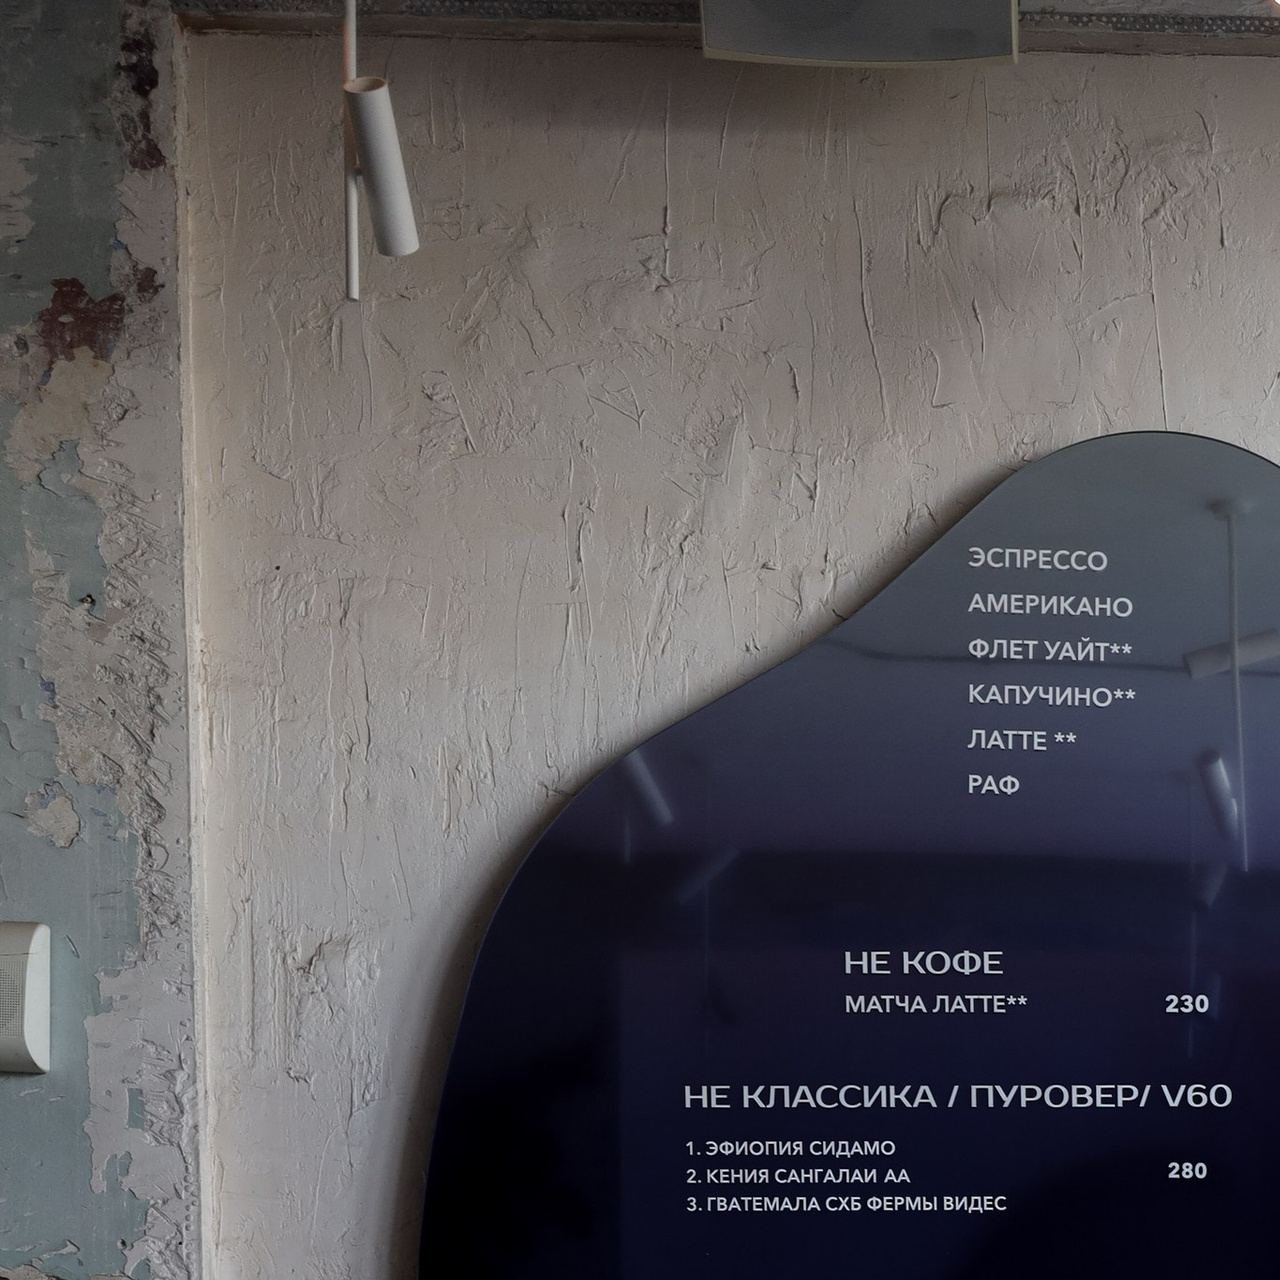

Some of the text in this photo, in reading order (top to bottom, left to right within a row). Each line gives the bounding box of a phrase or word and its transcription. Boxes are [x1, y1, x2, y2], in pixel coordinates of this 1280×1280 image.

[969, 547, 1107, 570] ЭСПРЕССО
[968, 594, 1132, 617] АМЕРИКАНО
[969, 639, 1038, 659] ФЛЕТ
[968, 730, 1046, 750] ЛАТТЕ
[969, 775, 1019, 794] РАФ
[846, 951, 1003, 975] НЕ КОФЕ
[846, 996, 927, 1012] МАТЧА
[1166, 995, 1208, 1012] 230
[685, 1085, 1232, 1108] НЕ КЛАССИКА / ПУРОВЕР/ V60
[687, 1141, 895, 1158] 1. ЭФИОПИЯ СИДАМО
[687, 1169, 910, 1183] 2. КЕНИЯ САНГАЛАИ АА
[1169, 1162, 1207, 1178] 280
[687, 1196, 1006, 1213] 3. ГВАТЕМАЛА СХБ ФЕРМЫ ВИДЕС
